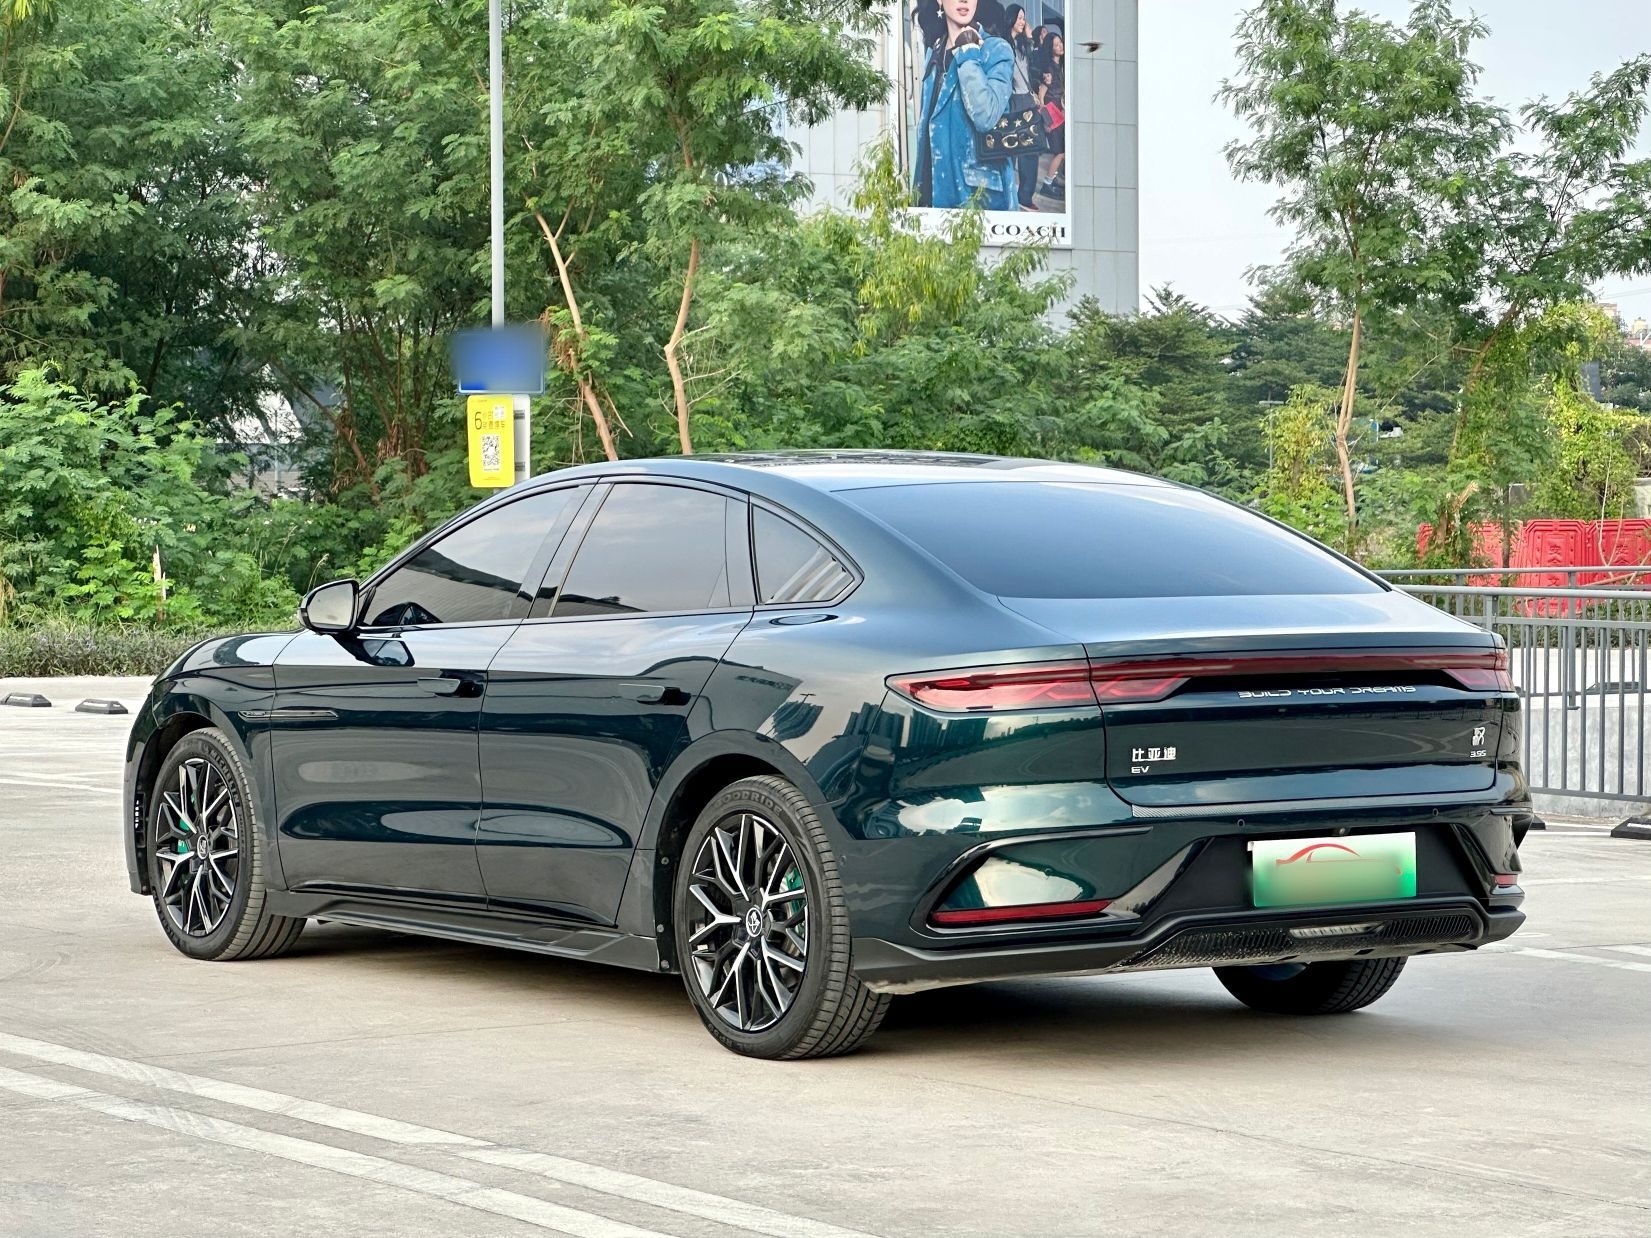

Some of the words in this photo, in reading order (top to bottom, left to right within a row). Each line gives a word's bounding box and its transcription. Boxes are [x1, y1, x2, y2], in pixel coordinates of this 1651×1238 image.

[991, 224, 1066, 238] COACH
[474, 411, 483, 431] 6
[1238, 689, 1291, 698] BUILD
[1298, 687, 1345, 696] YOUR
[1350, 685, 1417, 694] DREAMS
[1131, 746, 1176, 762] 比亚迪
[1131, 765, 1150, 774] EV
[713, 790, 783, 816] GOODRIDE
